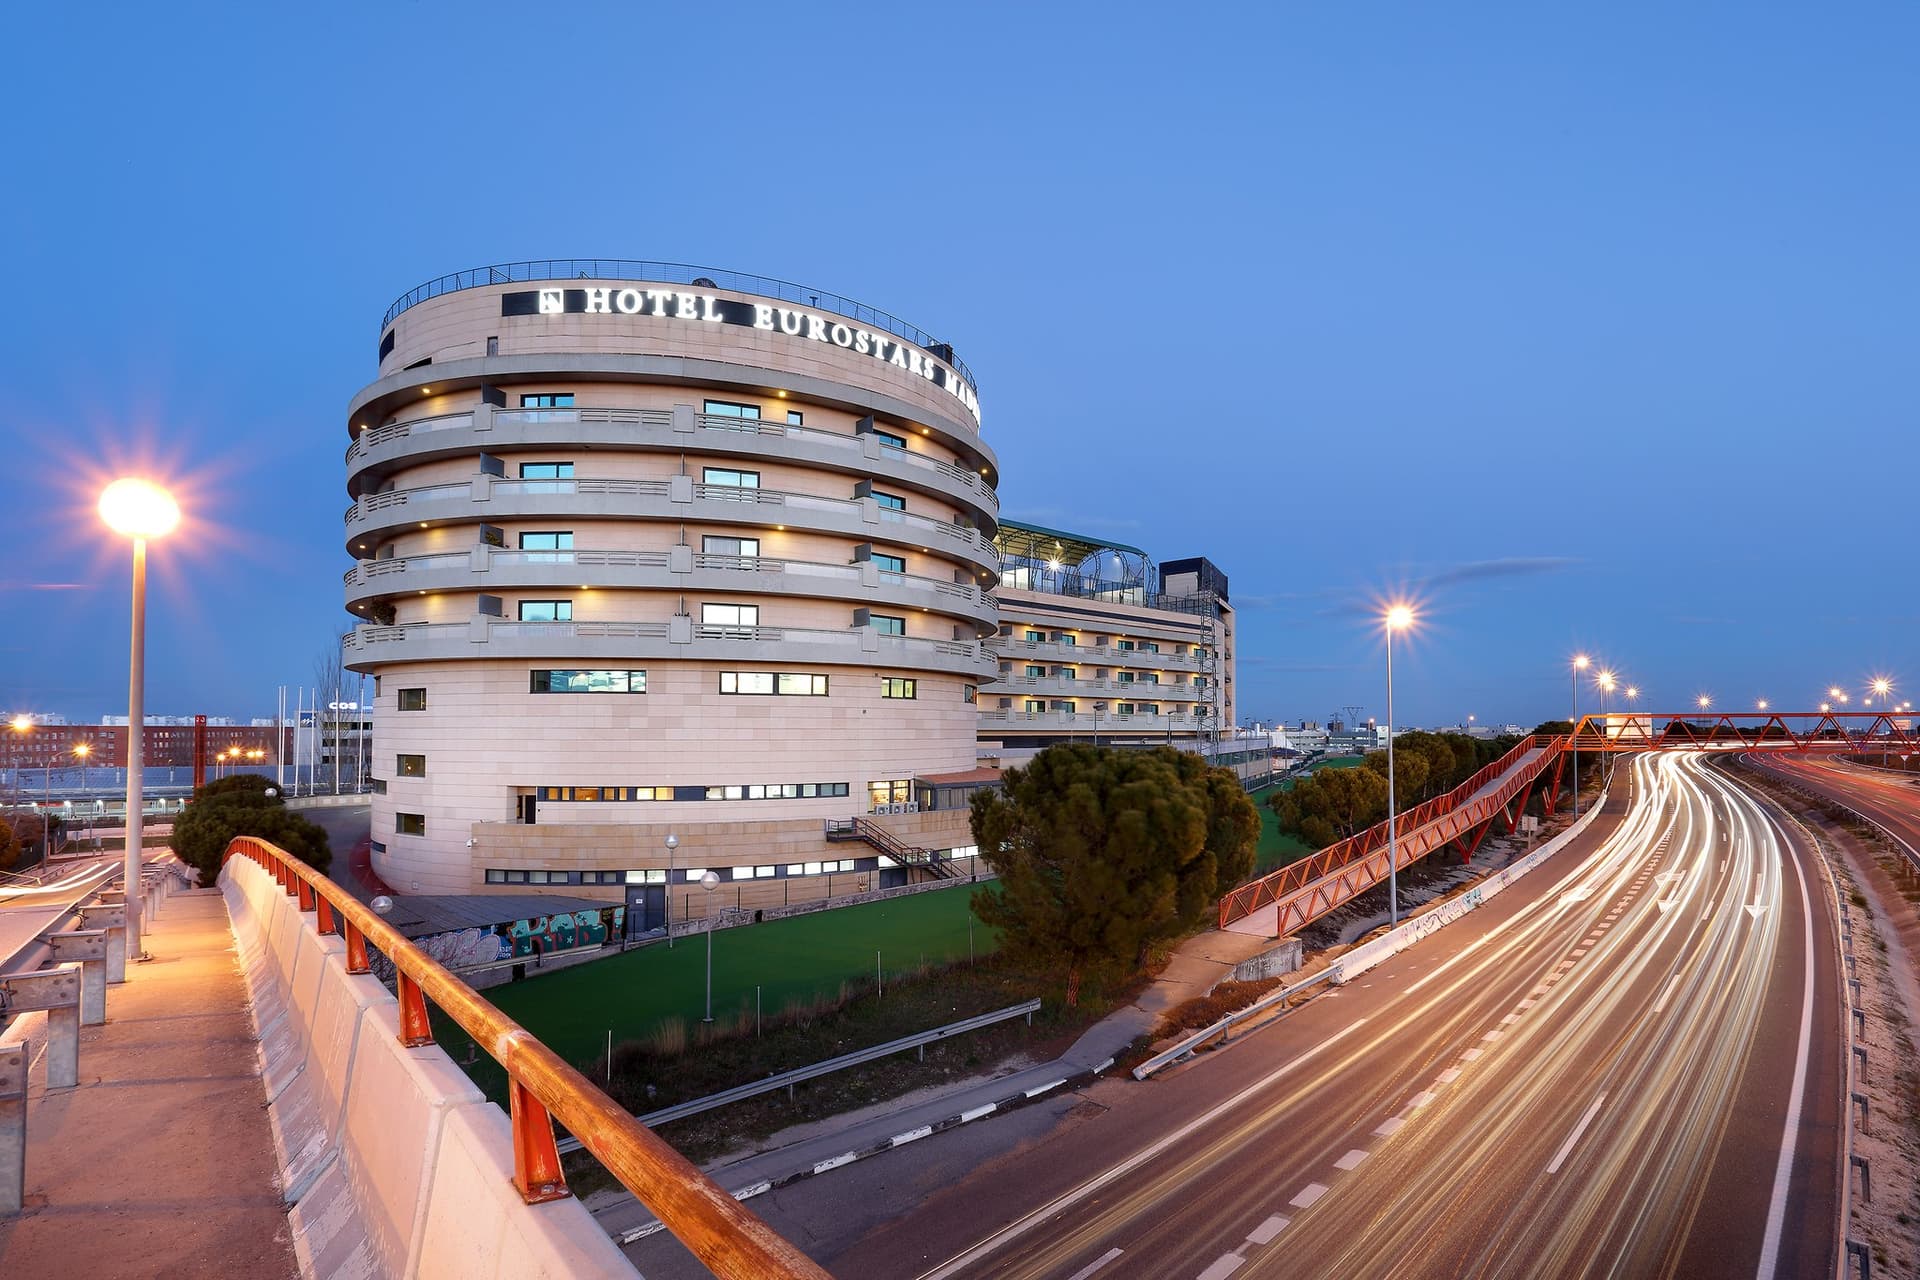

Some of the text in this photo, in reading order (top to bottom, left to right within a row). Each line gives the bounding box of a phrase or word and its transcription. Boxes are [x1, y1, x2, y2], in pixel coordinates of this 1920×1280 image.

[584, 287, 981, 436] HOTEL EUROSTARS MAD
